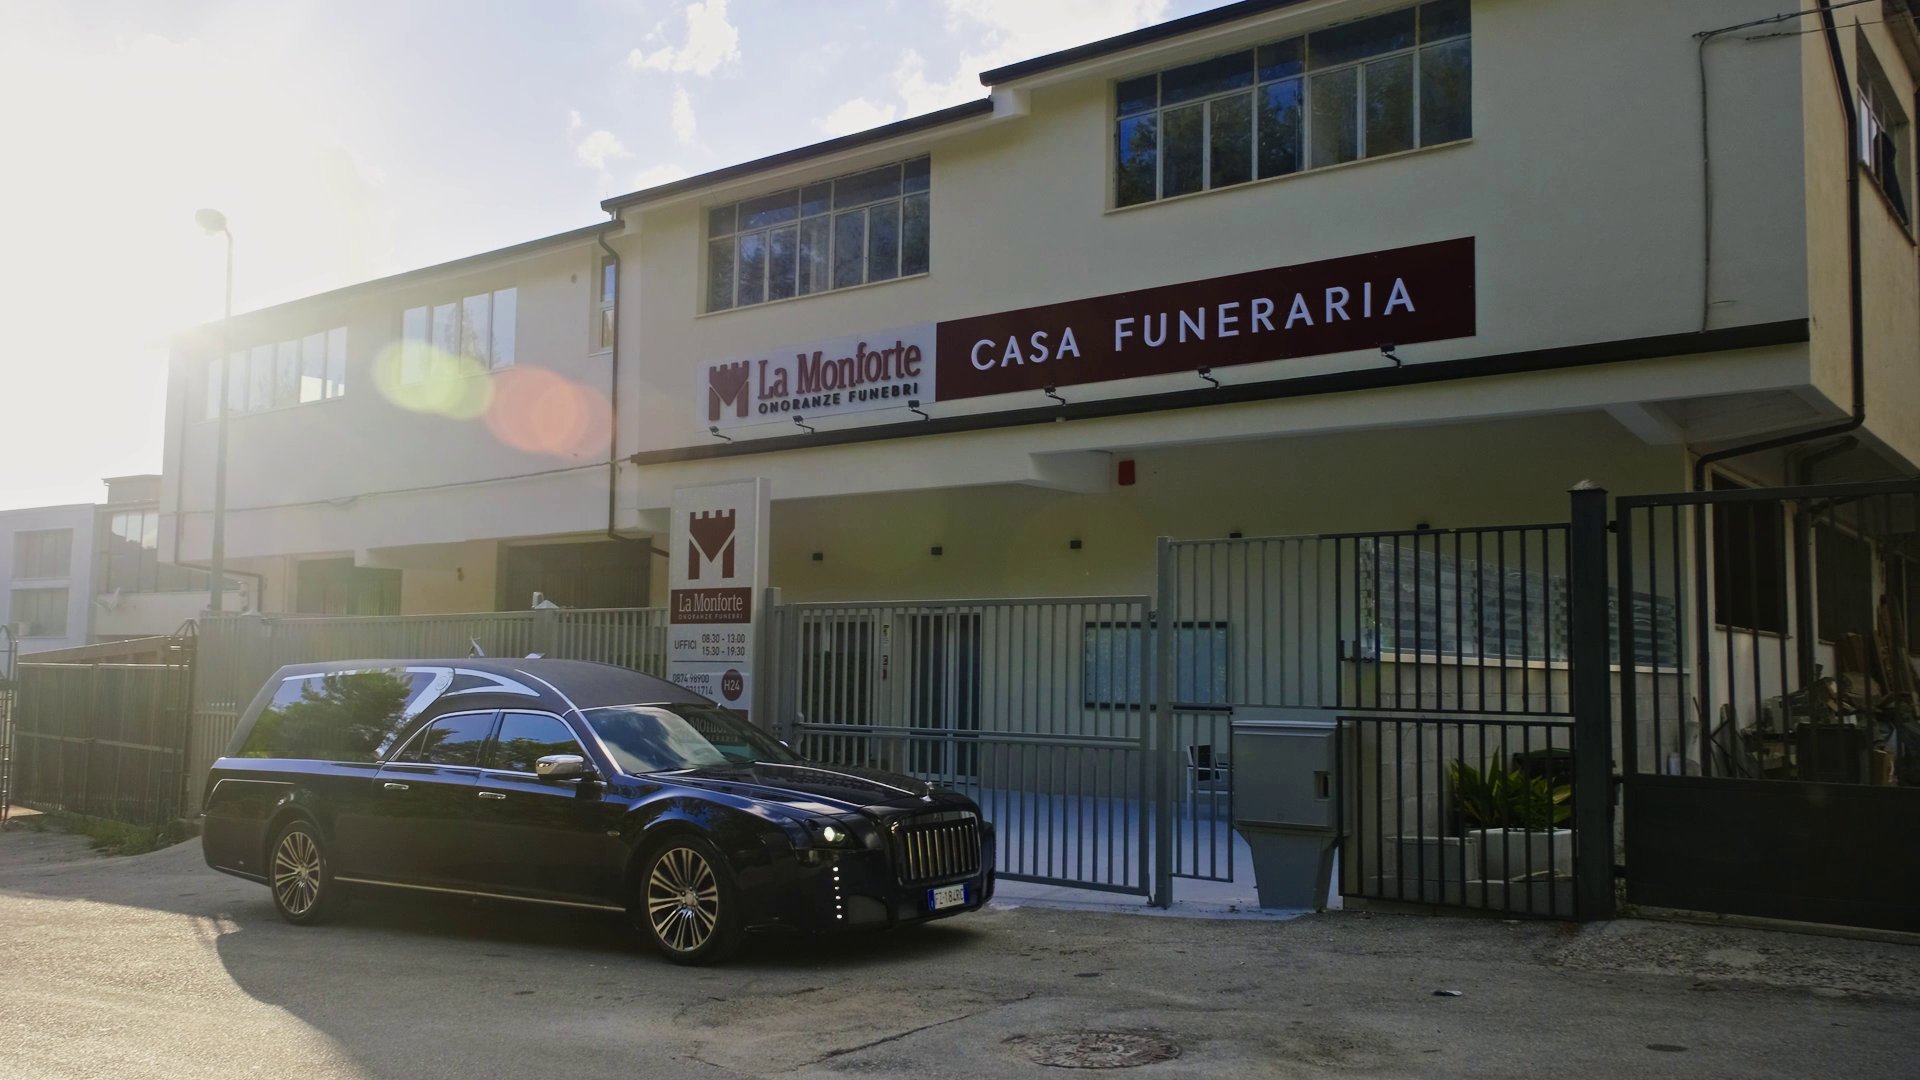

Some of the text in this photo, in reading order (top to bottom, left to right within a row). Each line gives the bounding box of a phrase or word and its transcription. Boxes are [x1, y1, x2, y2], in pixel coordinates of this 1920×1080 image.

[970, 277, 1416, 371] CASA FUNERARIA
[757, 340, 922, 400] La Monforte
[758, 383, 919, 414] ONORANZE FUNEBRI
[679, 592, 743, 612] La Monforte
[674, 640, 697, 650] UFFICI
[701, 633, 720, 643] 08:30
[727, 633, 746, 643] 13:00
[702, 646, 720, 656] 15:30
[727, 646, 746, 656] 19:30
[724, 679, 740, 691] H24
